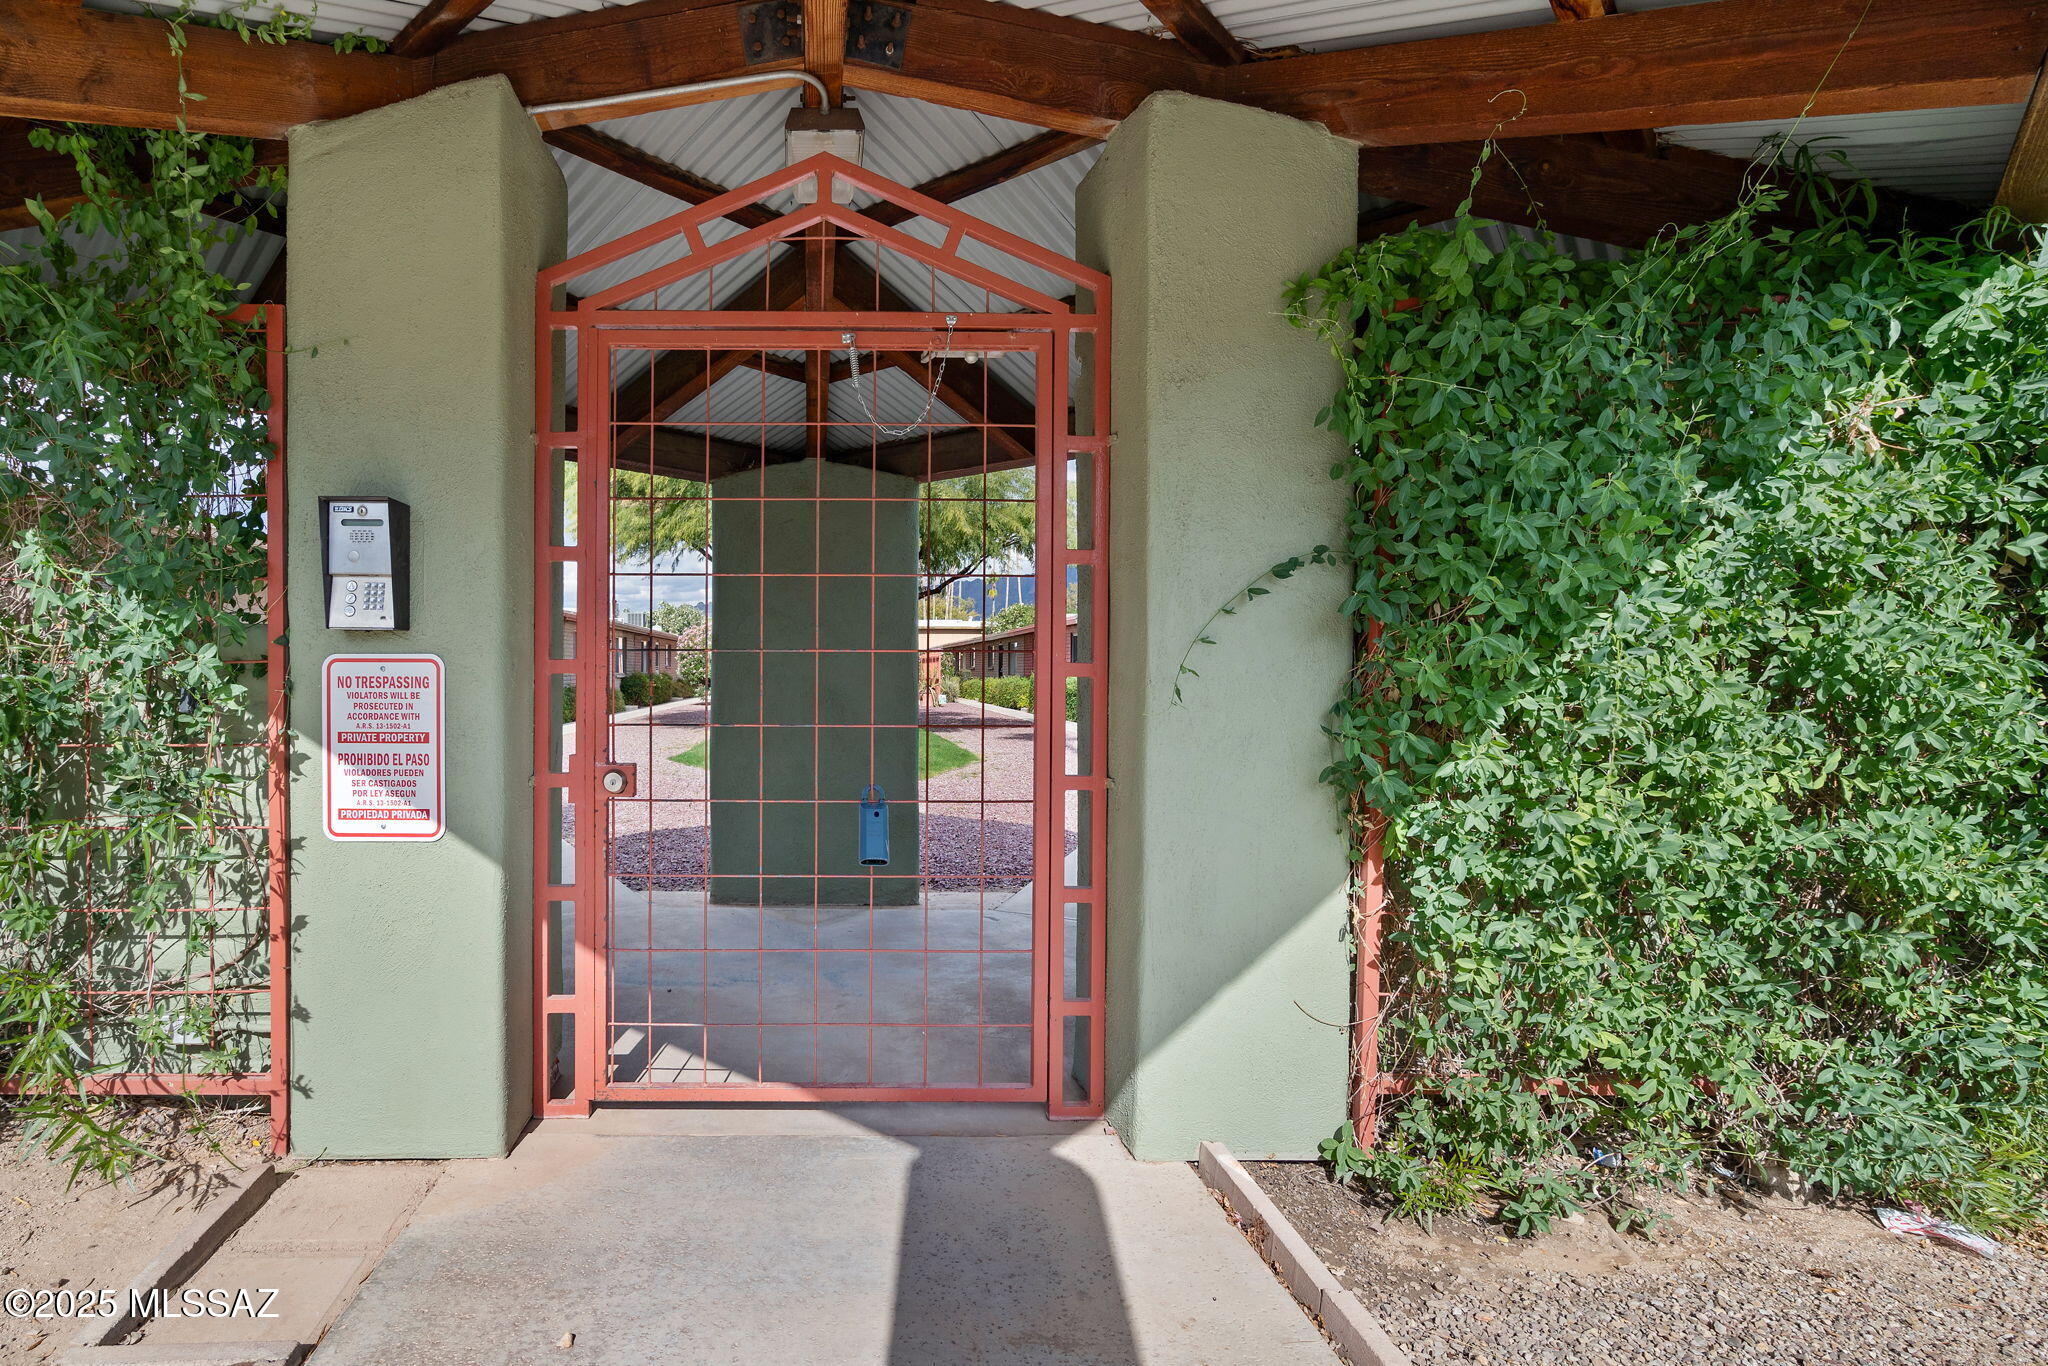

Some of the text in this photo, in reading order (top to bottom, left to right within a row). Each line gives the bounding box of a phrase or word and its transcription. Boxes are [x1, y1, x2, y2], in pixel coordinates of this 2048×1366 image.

[338, 676, 430, 689] NO TRESPASSING
[342, 733, 425, 742] PRIVATE PROPERTY
[338, 753, 430, 766] PROHIBIDO EL PASO
[341, 810, 428, 819] PROPIEDAD PRIVADA
